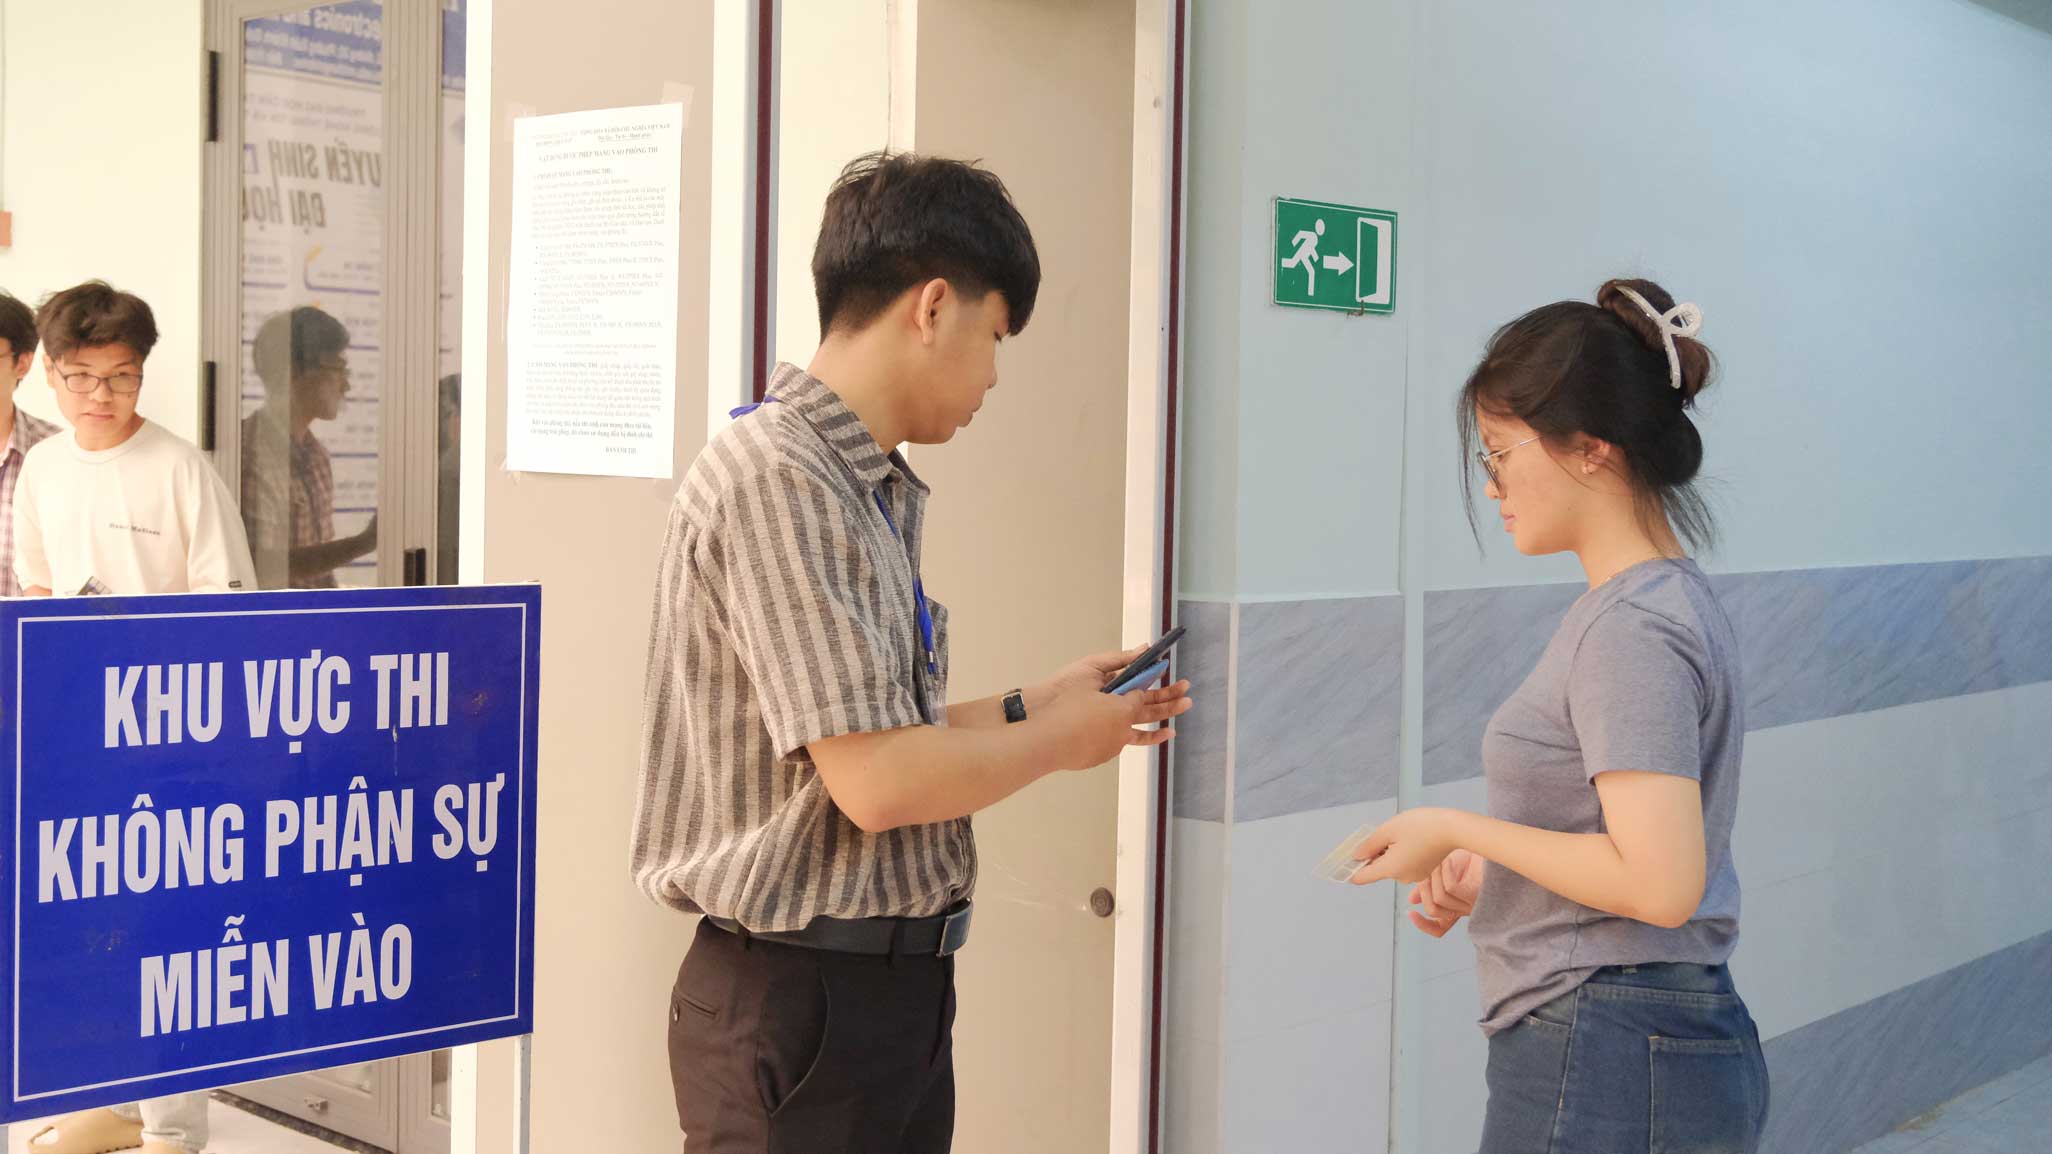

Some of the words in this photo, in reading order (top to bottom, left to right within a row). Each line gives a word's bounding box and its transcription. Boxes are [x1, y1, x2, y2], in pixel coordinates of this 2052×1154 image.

[105, 662, 223, 748] KHU
[244, 649, 351, 754] VỰC
[370, 652, 449, 730] THI
[38, 793, 244, 903] KHÔNG
[266, 776, 413, 887] PHẬN
[433, 773, 505, 872] SỰ
[140, 914, 289, 1037] MIỄN
[309, 912, 412, 1010] VÀO
